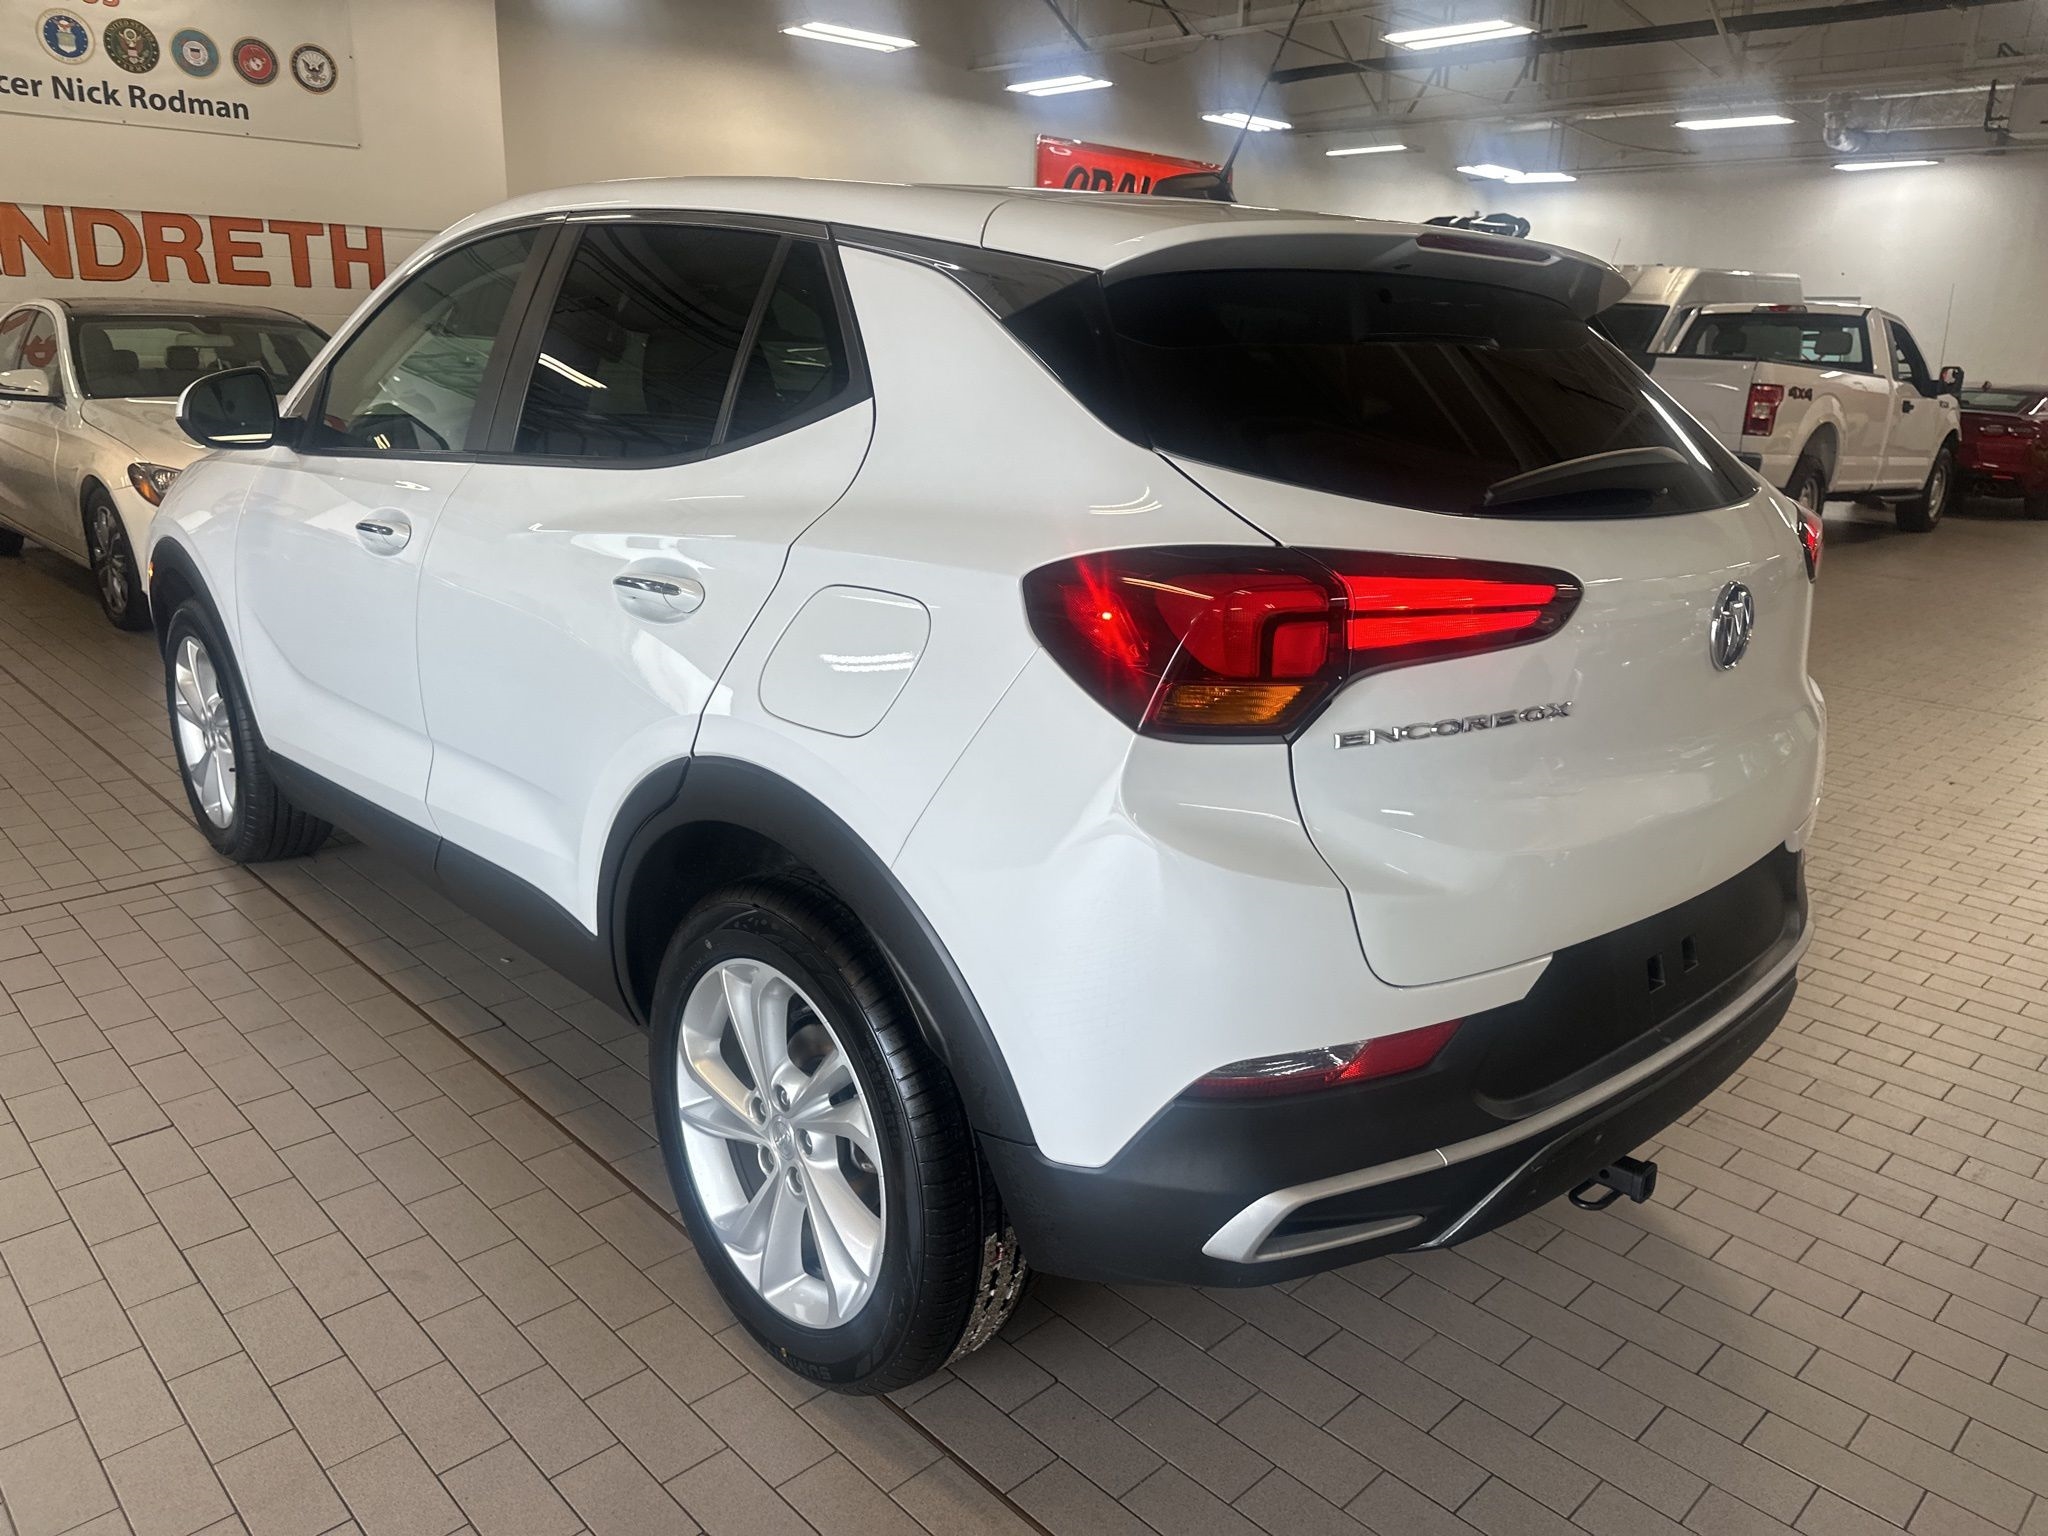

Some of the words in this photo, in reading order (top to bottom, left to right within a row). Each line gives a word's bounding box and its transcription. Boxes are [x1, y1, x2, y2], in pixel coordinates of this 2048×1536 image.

[51, 75, 122, 107] Nick
[128, 85, 250, 120] Rodman
[0, 202, 387, 290] NDRETH
[1334, 709, 1519, 750] ENCORE
[1519, 700, 1573, 723] GX
